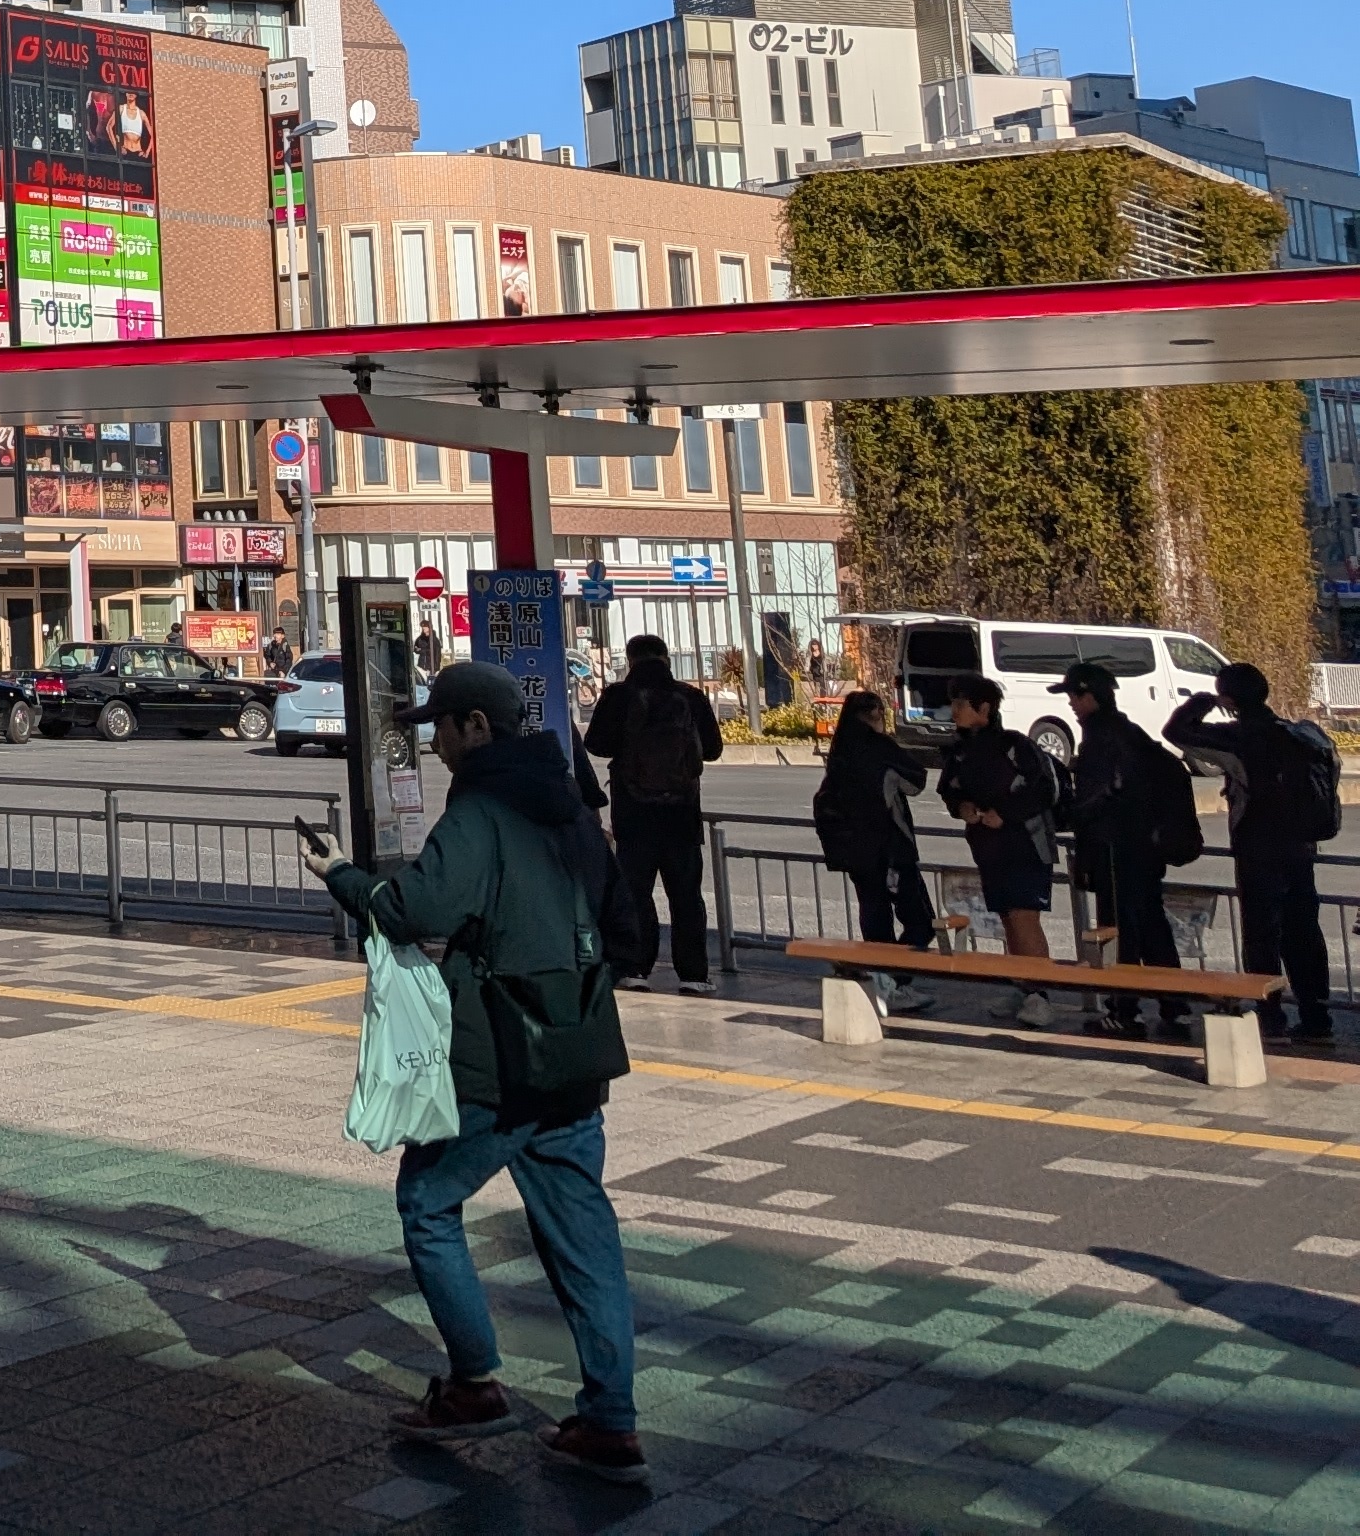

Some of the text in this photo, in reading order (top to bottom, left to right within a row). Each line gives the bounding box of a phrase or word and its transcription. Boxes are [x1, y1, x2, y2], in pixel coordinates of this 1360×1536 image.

[45, 38, 90, 64] SALUS
[96, 33, 147, 50] PERSONAL
[96, 45, 147, 62] TRAINING
[101, 61, 148, 89] GYM
[281, 94, 288, 105] 2
[63, 227, 152, 258] Room Spot
[501, 246, 526, 260] エステ
[31, 299, 93, 329] POLUS
[98, 534, 142, 552] SEPIA
[494, 577, 553, 598] のりば
[488, 601, 514, 665] 浅間下
